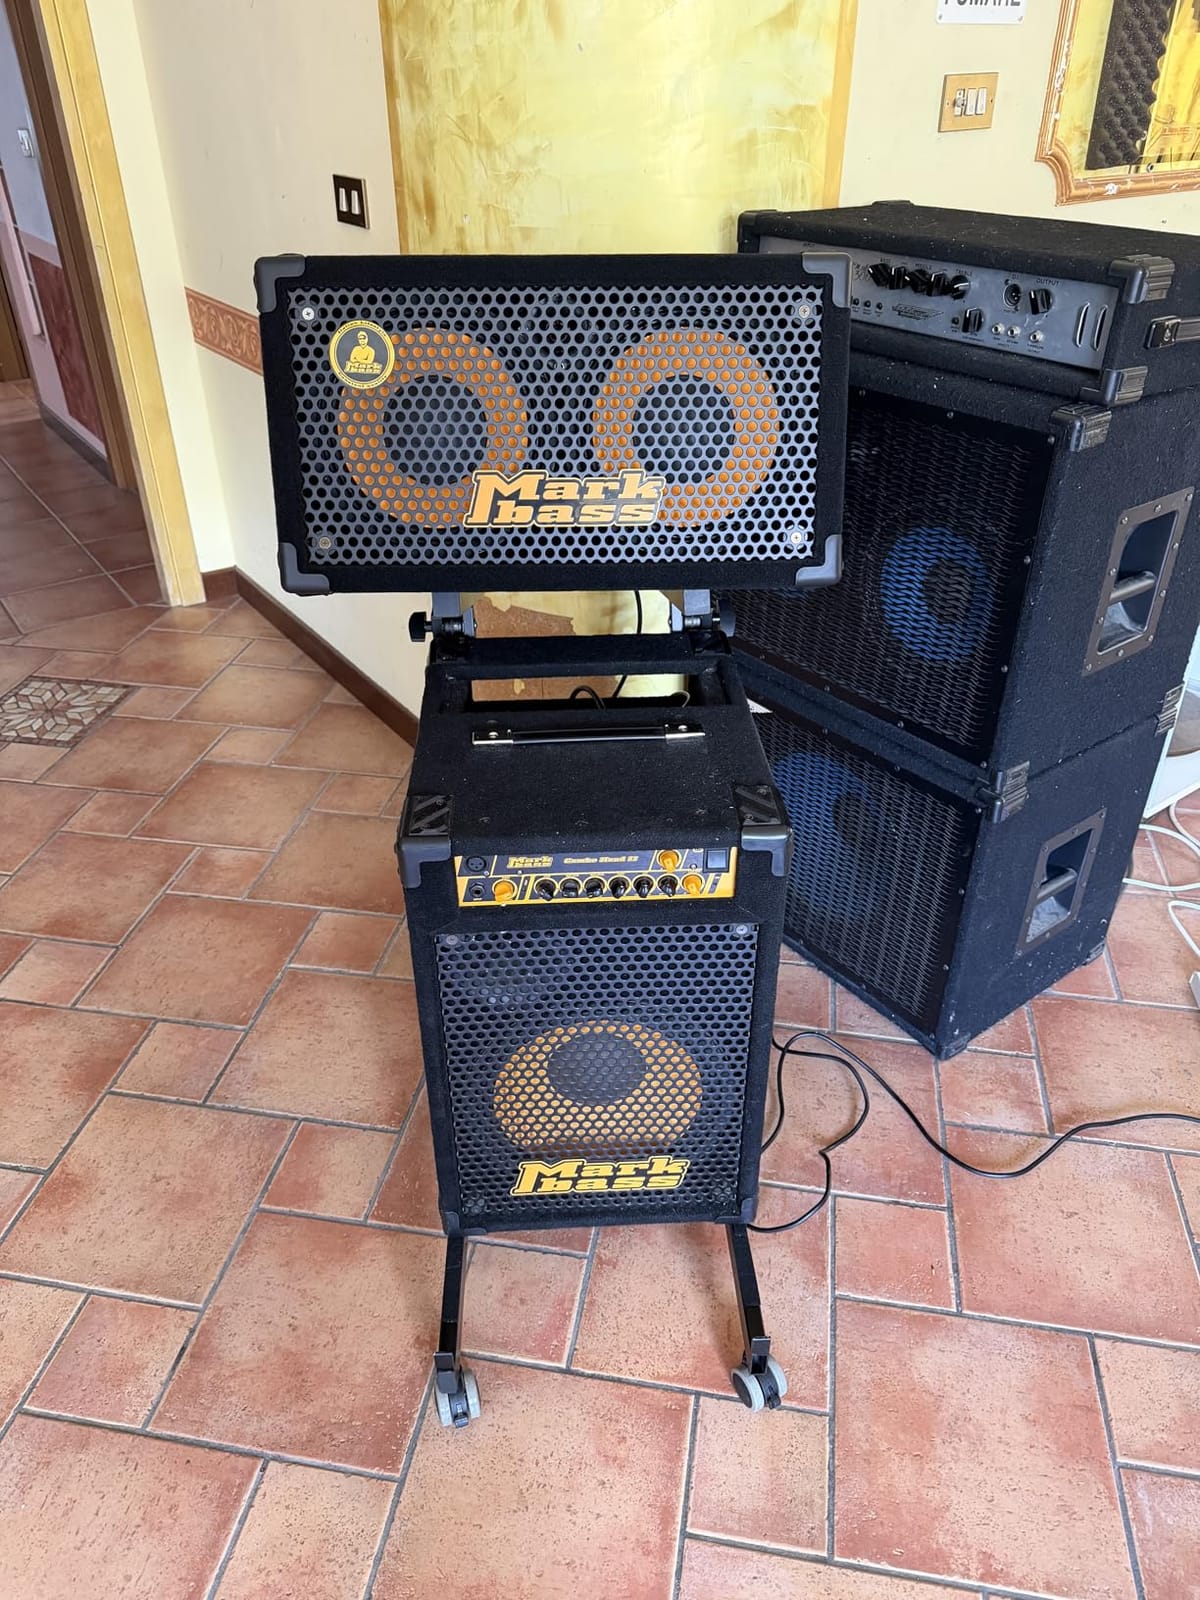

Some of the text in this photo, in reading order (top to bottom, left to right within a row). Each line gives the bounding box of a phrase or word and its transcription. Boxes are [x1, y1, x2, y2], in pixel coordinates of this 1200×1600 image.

[1035, 277, 1060, 287] OUTPUT
[467, 472, 663, 524] Mark
[492, 499, 658, 524] bass
[514, 1158, 687, 1193] Mark
[536, 1175, 681, 1193] bass
